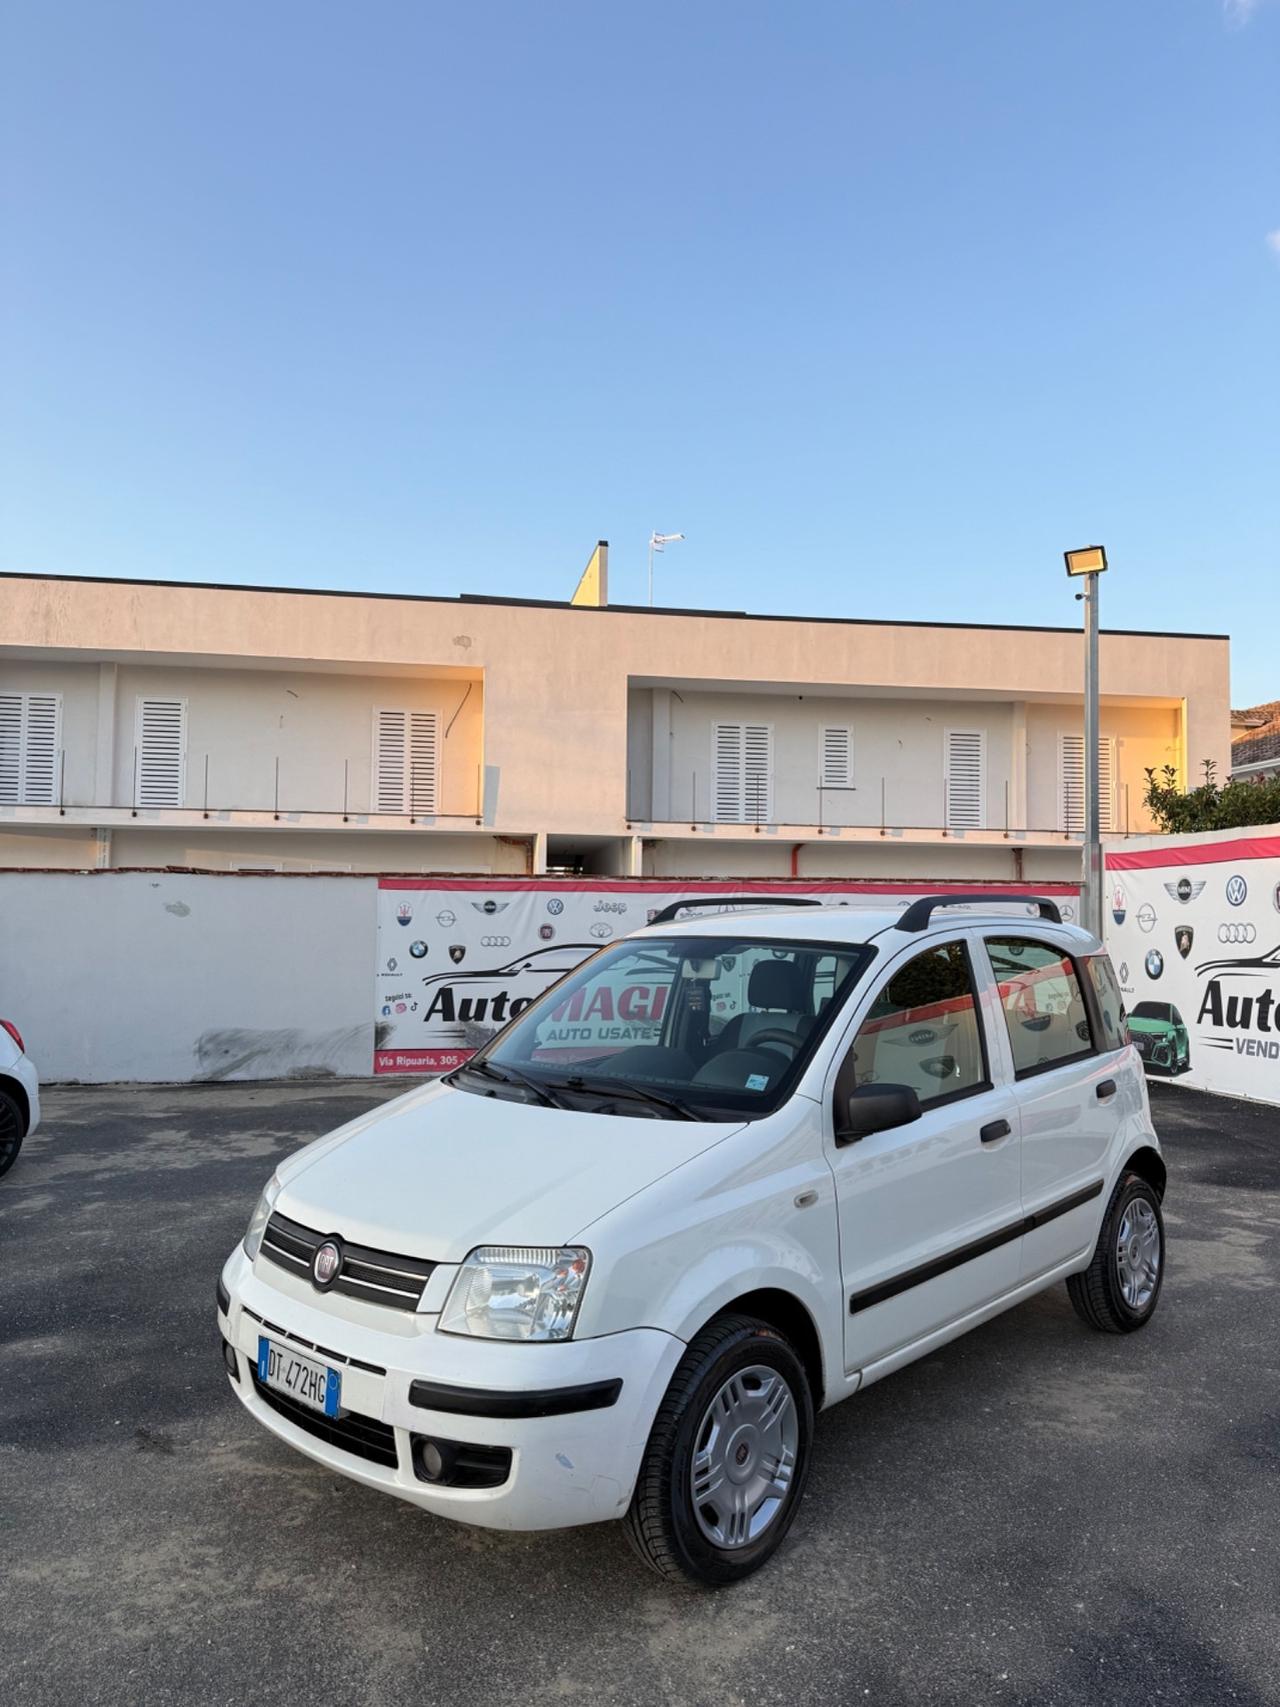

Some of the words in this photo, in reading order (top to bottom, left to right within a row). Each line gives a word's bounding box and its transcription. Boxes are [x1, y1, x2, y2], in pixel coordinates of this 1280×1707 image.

[593, 900, 628, 914] Jeep
[1197, 980, 1280, 1033] Aut
[547, 1028, 591, 1041] AUTO
[379, 1056, 393, 1066] Via
[440, 1056, 458, 1064] 305
